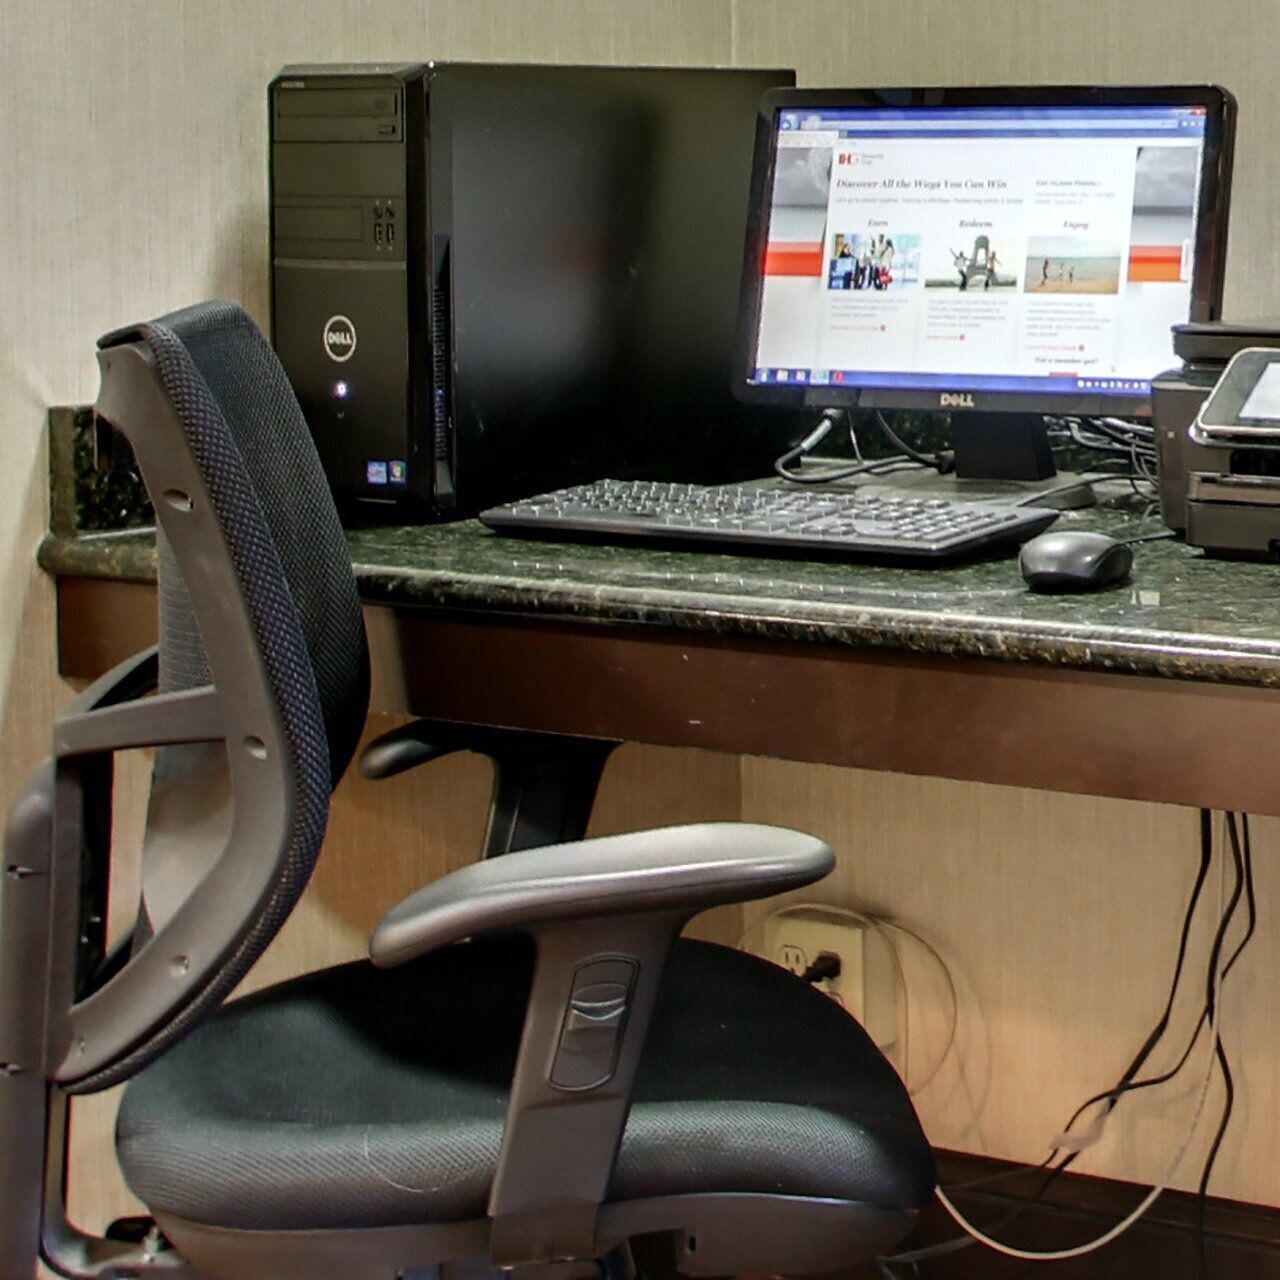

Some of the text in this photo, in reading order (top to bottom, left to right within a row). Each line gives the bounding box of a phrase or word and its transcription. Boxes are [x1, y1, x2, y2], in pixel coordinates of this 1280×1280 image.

[837, 179, 1008, 191] Discover All the Ways You Can Win
[327, 331, 352, 346] DELL
[939, 393, 975, 408] DELL
